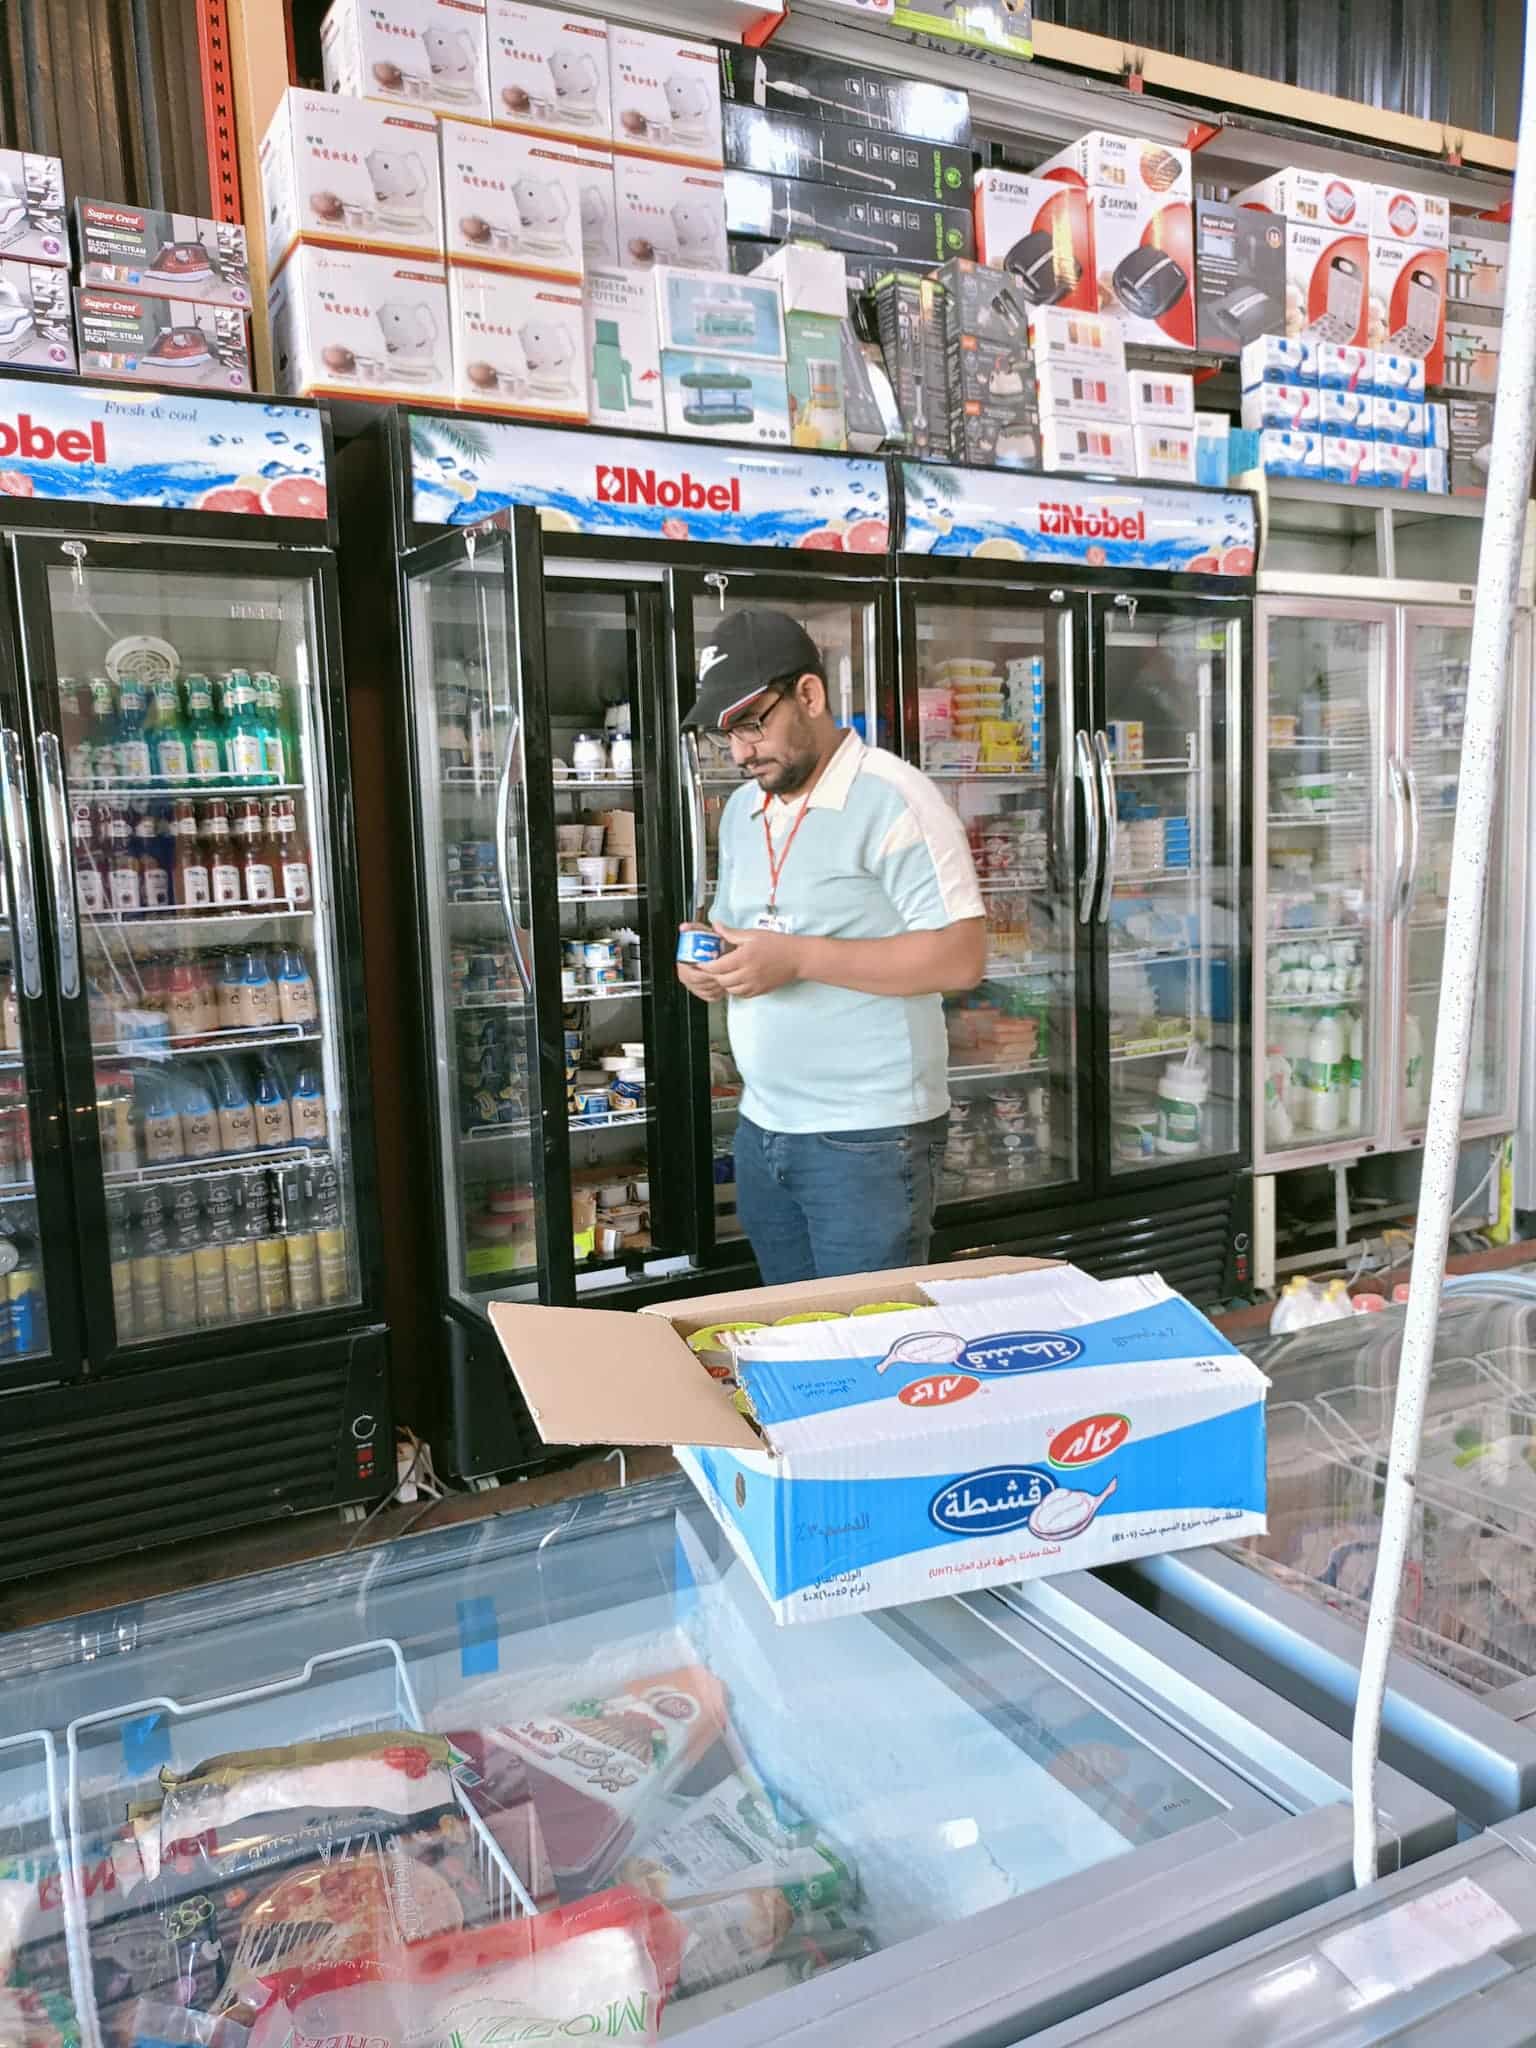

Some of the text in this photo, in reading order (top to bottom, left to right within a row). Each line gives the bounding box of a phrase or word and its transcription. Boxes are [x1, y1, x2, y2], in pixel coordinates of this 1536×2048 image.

[87, 208, 139, 225] Super Crest
[84, 299, 137, 313] Super Crest
[104, 400, 199, 422] Fresh & cool
[627, 467, 741, 512] Nobel
[1062, 504, 1145, 541] Nobel
[966, 1340, 1070, 1369] قشطة
[943, 1477, 1043, 1519] قشطة
